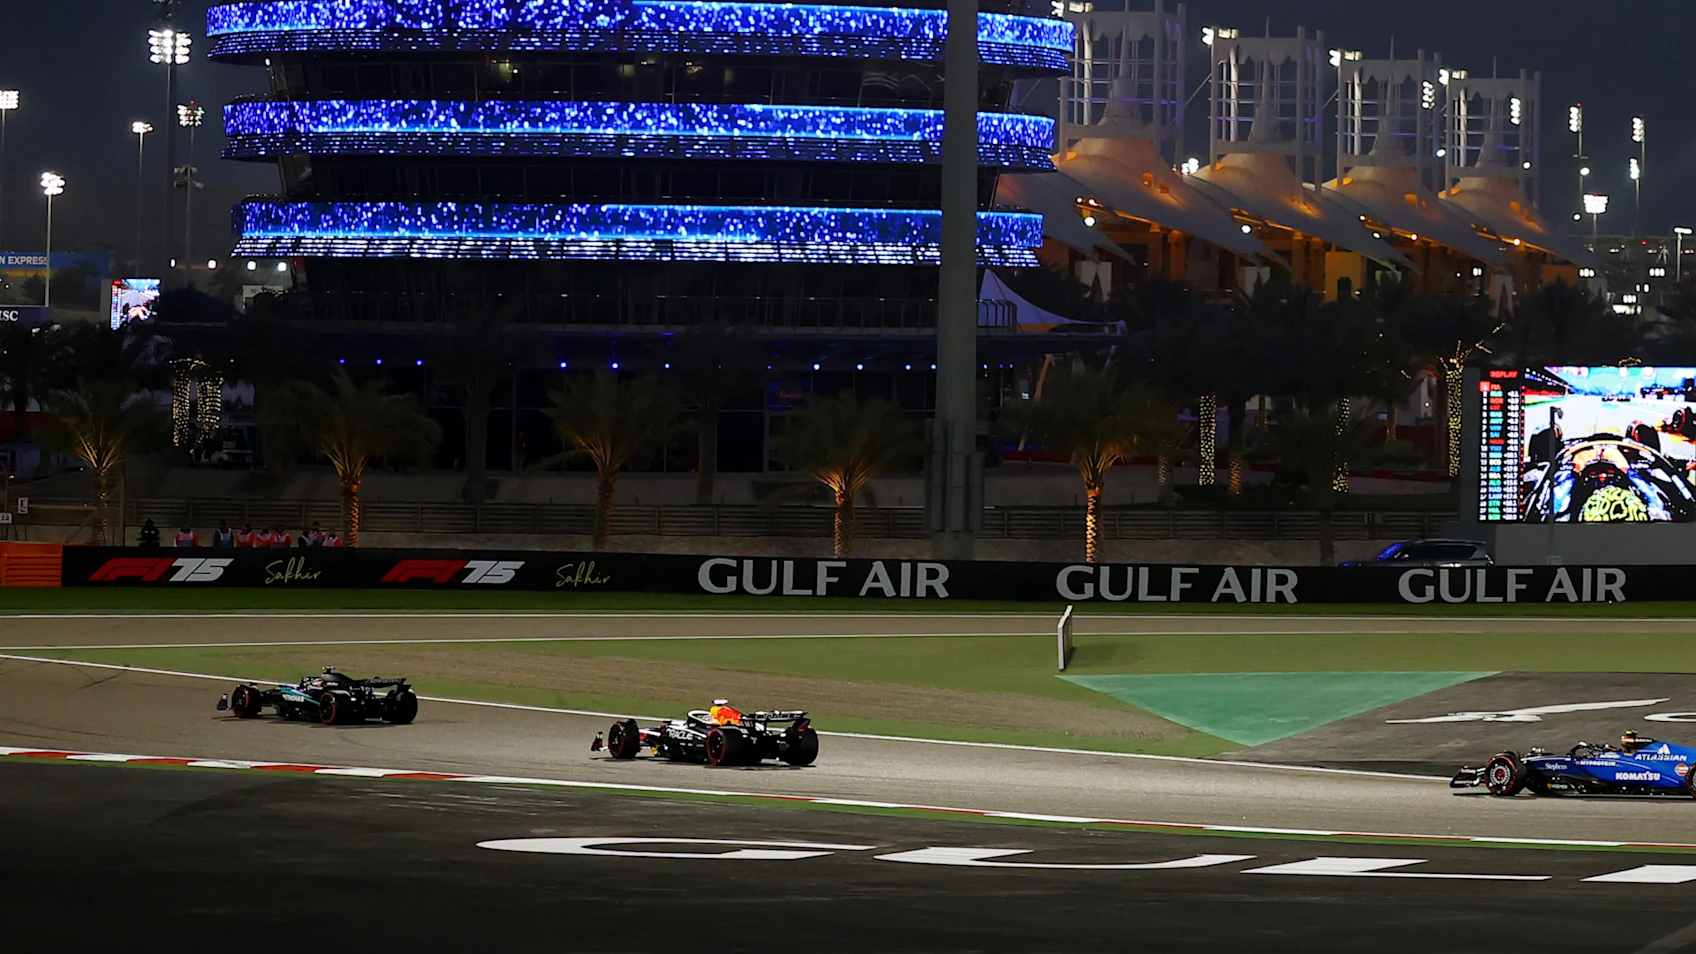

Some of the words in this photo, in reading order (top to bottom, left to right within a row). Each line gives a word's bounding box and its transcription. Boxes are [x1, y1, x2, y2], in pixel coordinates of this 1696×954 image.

[264, 556, 321, 584] Sakhir
[555, 560, 611, 588] Sakhir
[698, 558, 847, 597] GULF
[858, 560, 951, 598] AIR
[1055, 565, 1199, 602] GULF
[1210, 566, 1299, 604] AIR
[1397, 567, 1535, 603] GULF
[1544, 566, 1627, 603] AIR
[1635, 754, 1687, 762] ATLASSIAN
[1615, 771, 1660, 781] KOMATSU
